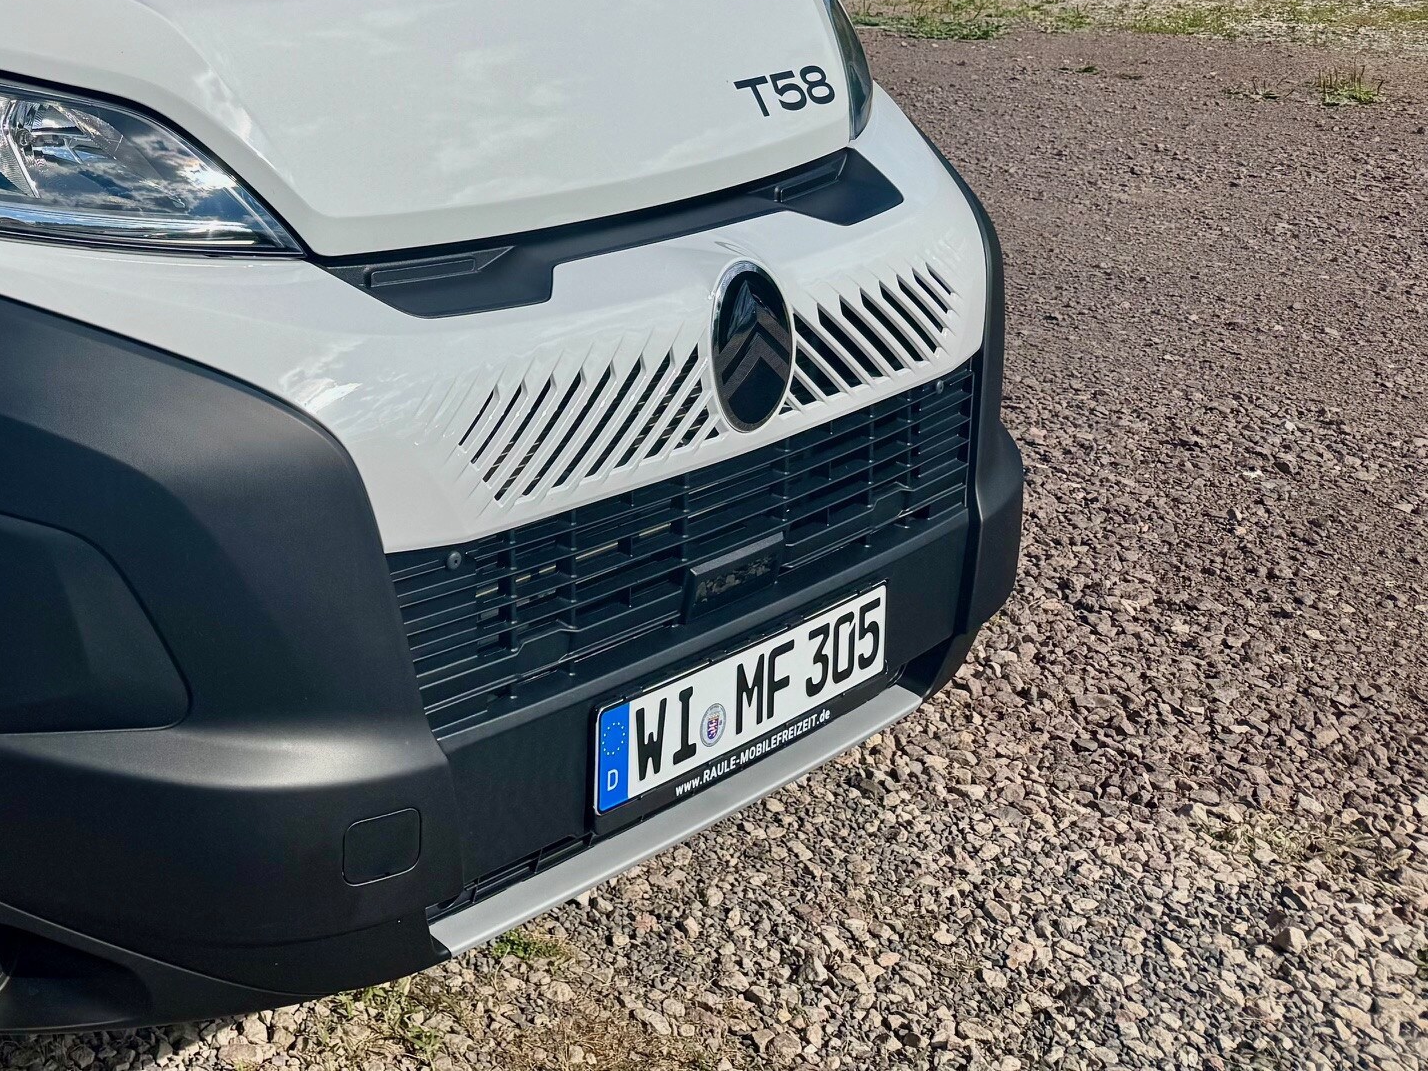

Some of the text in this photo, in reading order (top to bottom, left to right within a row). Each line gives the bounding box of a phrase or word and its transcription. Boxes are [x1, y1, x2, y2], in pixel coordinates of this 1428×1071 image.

[733, 65, 835, 117] T58
[607, 768, 619, 791] D
[635, 686, 697, 781] WI
[735, 639, 795, 735] MF
[805, 597, 881, 697] 305
[675, 708, 831, 797] www.RAULE-MOBILEFREIZEIT.de
